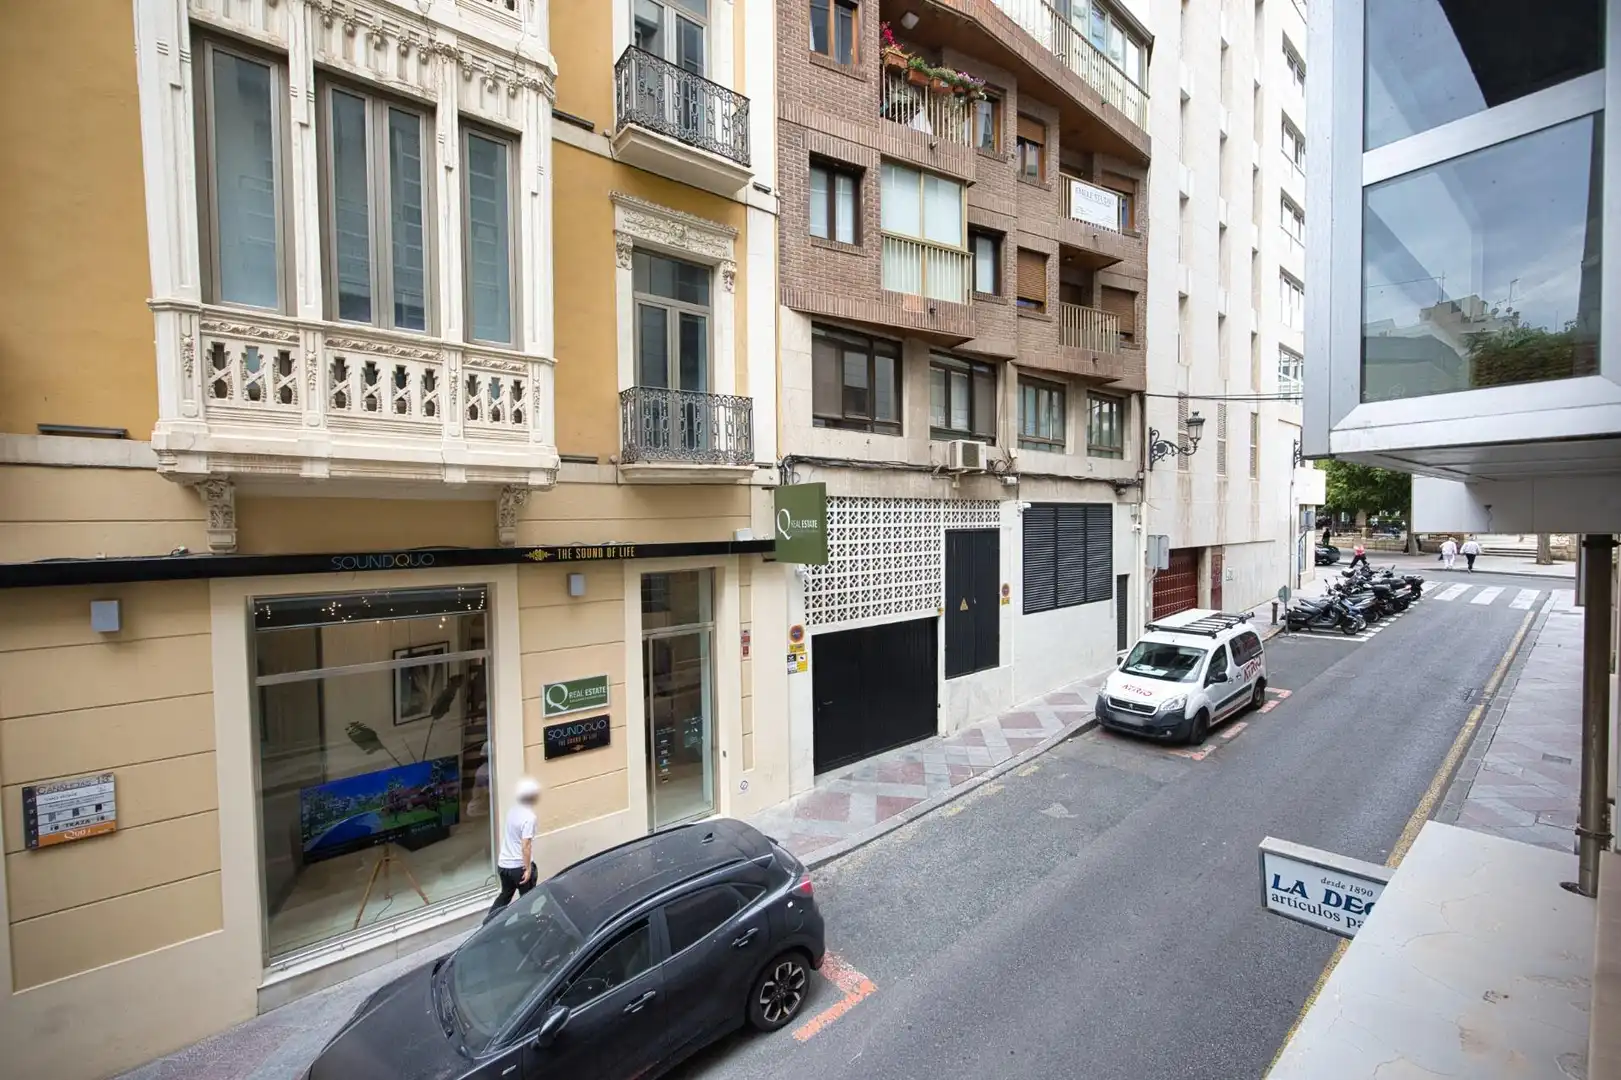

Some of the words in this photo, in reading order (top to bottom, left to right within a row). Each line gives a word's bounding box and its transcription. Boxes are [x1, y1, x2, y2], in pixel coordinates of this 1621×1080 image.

[777, 508, 792, 540] Q
[791, 520, 801, 528] REAL
[801, 520, 817, 528] ESTATE
[331, 553, 435, 570] SOUNDQUO
[557, 548, 572, 560] THE
[575, 547, 603, 559] SOUND
[607, 547, 616, 558] OF
[619, 546, 635, 557] LIFE
[546, 684, 569, 711] Q
[569, 690, 584, 699] REAL
[585, 687, 606, 696] ESTATE
[1271, 873, 1309, 899] LA
[1320, 876, 1346, 890] desde
[1349, 884, 1374, 898] 1890
[1271, 893, 1341, 923] artículos
